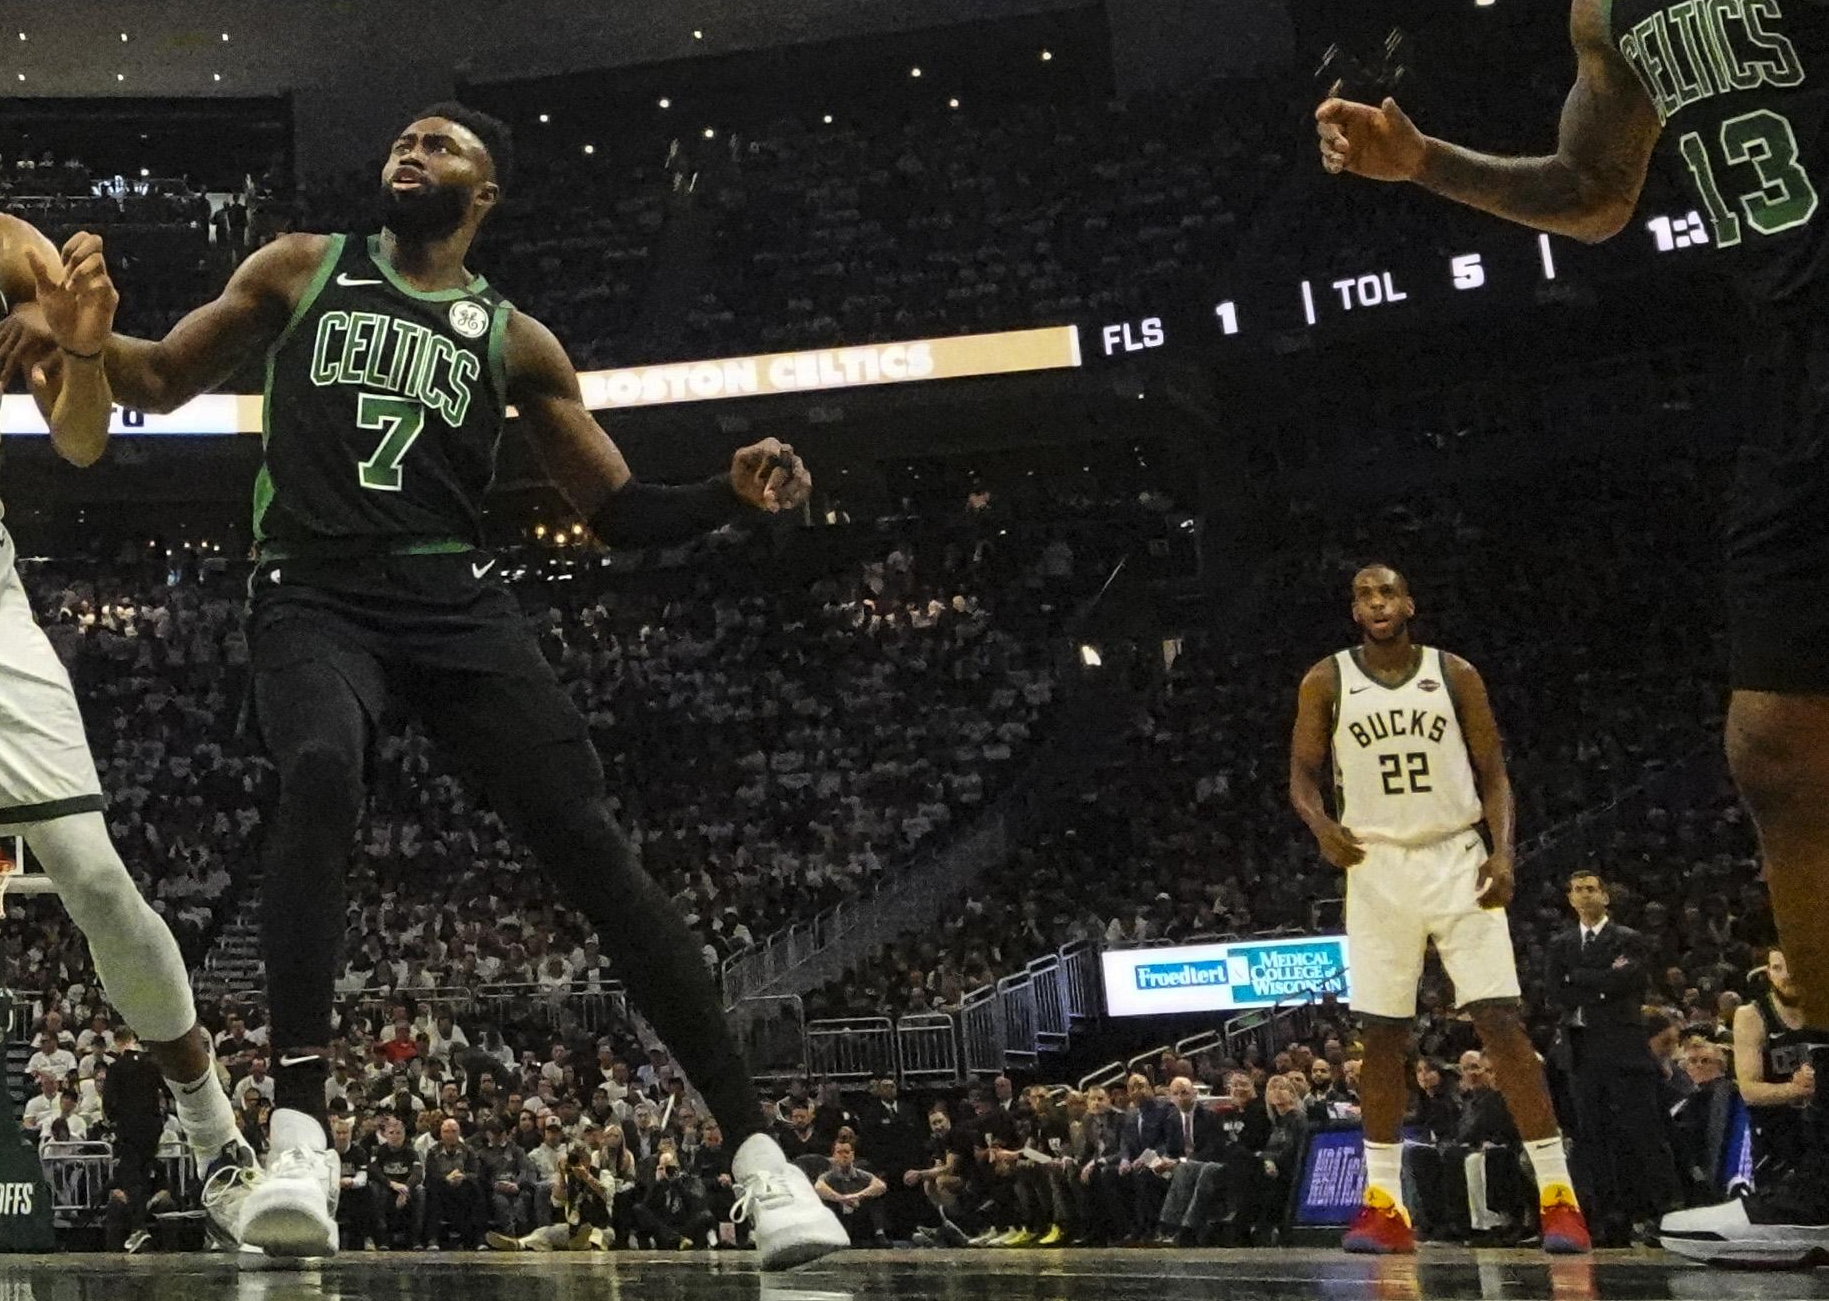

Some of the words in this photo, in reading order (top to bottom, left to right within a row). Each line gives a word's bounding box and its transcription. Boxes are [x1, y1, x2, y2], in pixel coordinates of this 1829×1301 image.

[1680, 108, 1818, 249] 13
[1333, 271, 1406, 310] TOL
[1451, 253, 1486, 290] 5
[1103, 316, 1164, 355] FLS
[1216, 301, 1239, 334] 1
[310, 310, 480, 428] CELTICS
[770, 343, 934, 391] CELTICS
[356, 393, 425, 491] 7
[1348, 709, 1447, 749] BUCKS
[1379, 751, 1433, 796] 22
[1251, 965, 1324, 982] COLLEGE
[1260, 950, 1332, 968] MEDICAL
